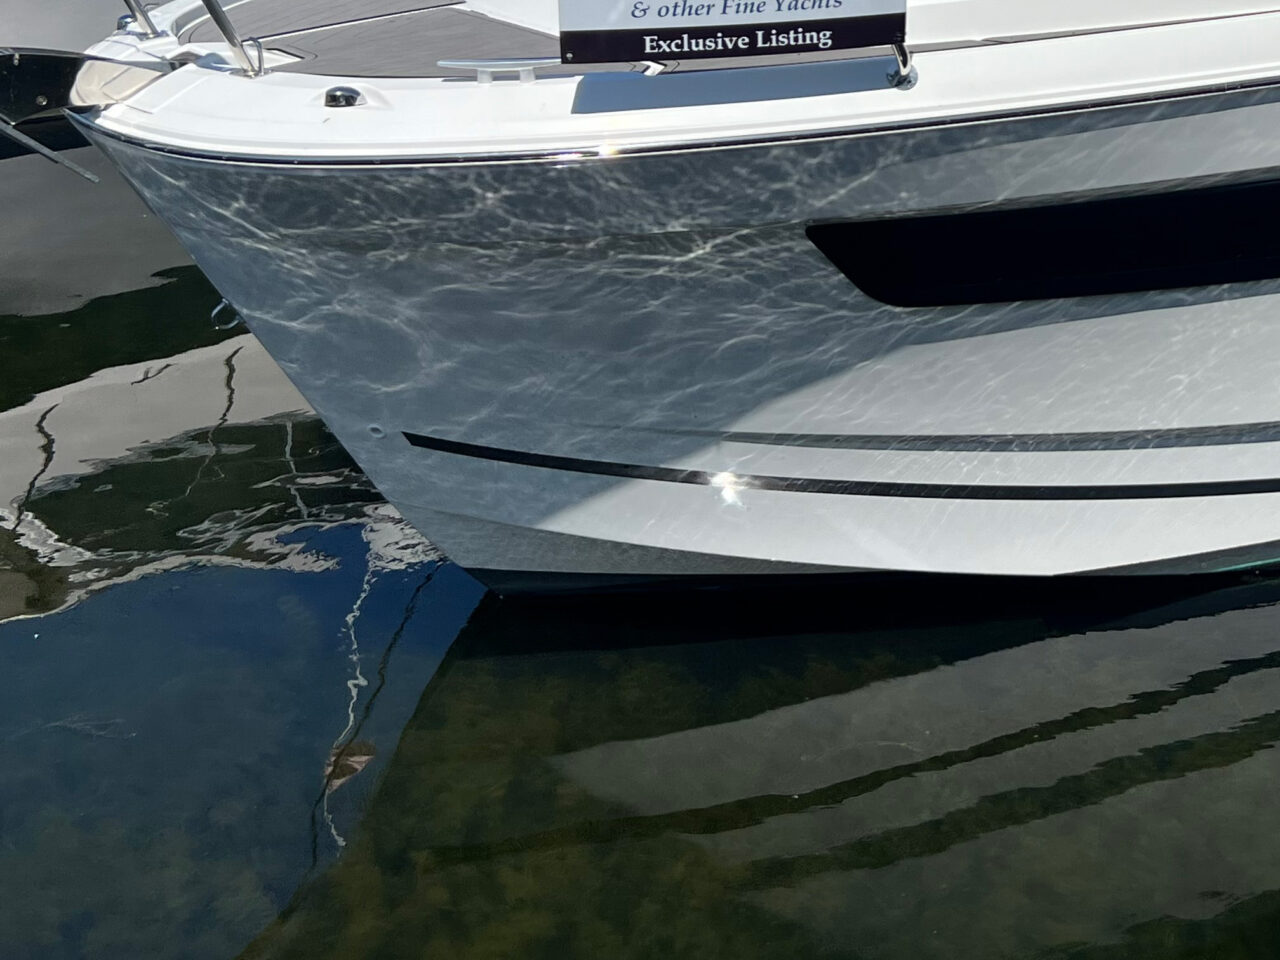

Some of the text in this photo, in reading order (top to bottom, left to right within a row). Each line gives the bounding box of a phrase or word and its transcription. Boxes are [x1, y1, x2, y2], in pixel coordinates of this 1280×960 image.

[631, 1, 650, 18] &
[643, 27, 833, 53] Exclusive Listing
